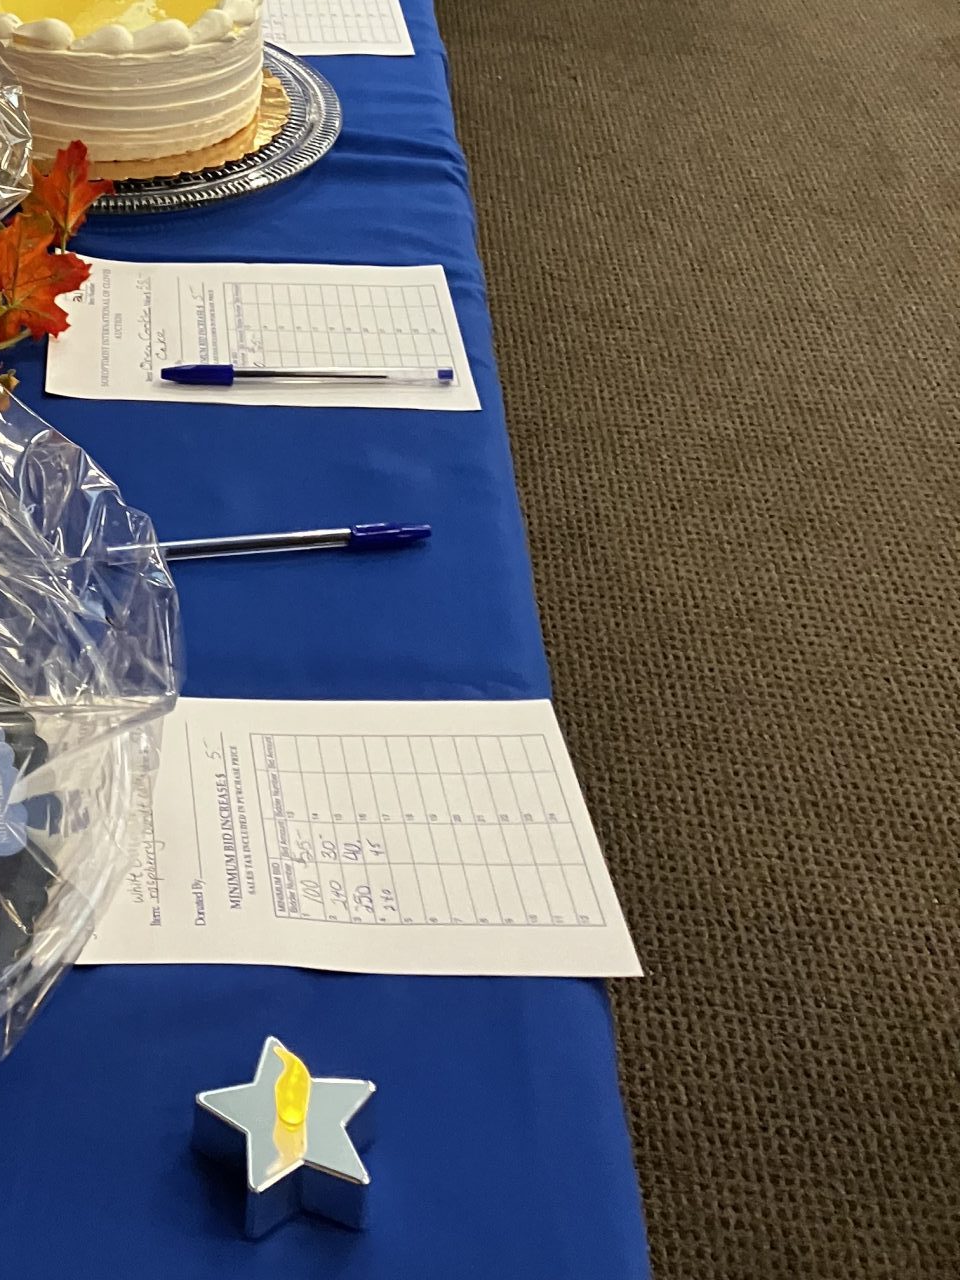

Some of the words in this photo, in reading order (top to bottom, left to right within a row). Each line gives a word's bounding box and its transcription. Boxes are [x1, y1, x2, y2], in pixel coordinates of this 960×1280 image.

[229, 746, 238, 766] PRICE
[234, 767, 244, 804] PURCHASE
[238, 804, 245, 813] IN
[223, 833, 234, 851] BID
[238, 815, 252, 852] INCLUDED
[366, 838, 384, 856] 45
[244, 855, 253, 869] TAX
[225, 854, 241, 909] MINIMUM
[246, 870, 256, 895] SALES
[194, 892, 205, 926] Donated
